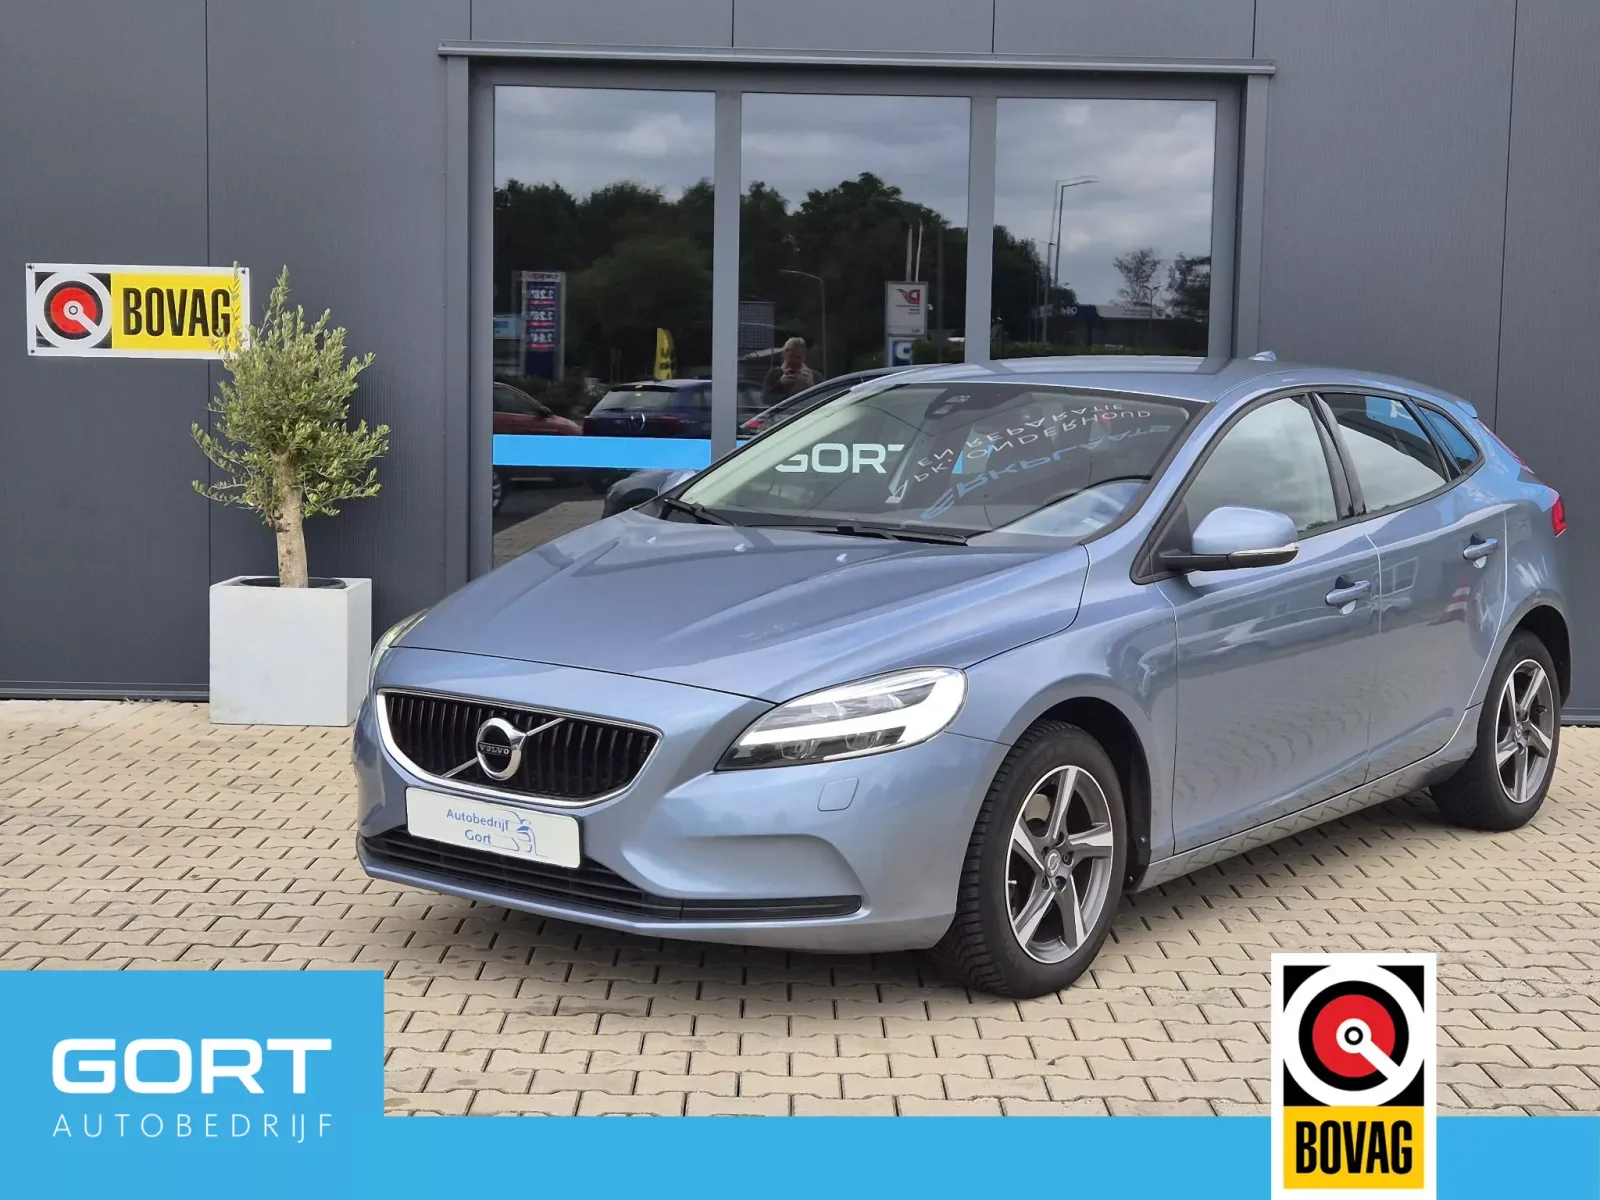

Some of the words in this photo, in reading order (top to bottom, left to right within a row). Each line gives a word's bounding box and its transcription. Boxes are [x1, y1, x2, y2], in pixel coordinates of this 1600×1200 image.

[123, 287, 231, 337] BOVAG
[479, 744, 510, 755] VOLVO
[446, 808, 509, 832] Autobedrijf
[464, 829, 491, 844] Gort
